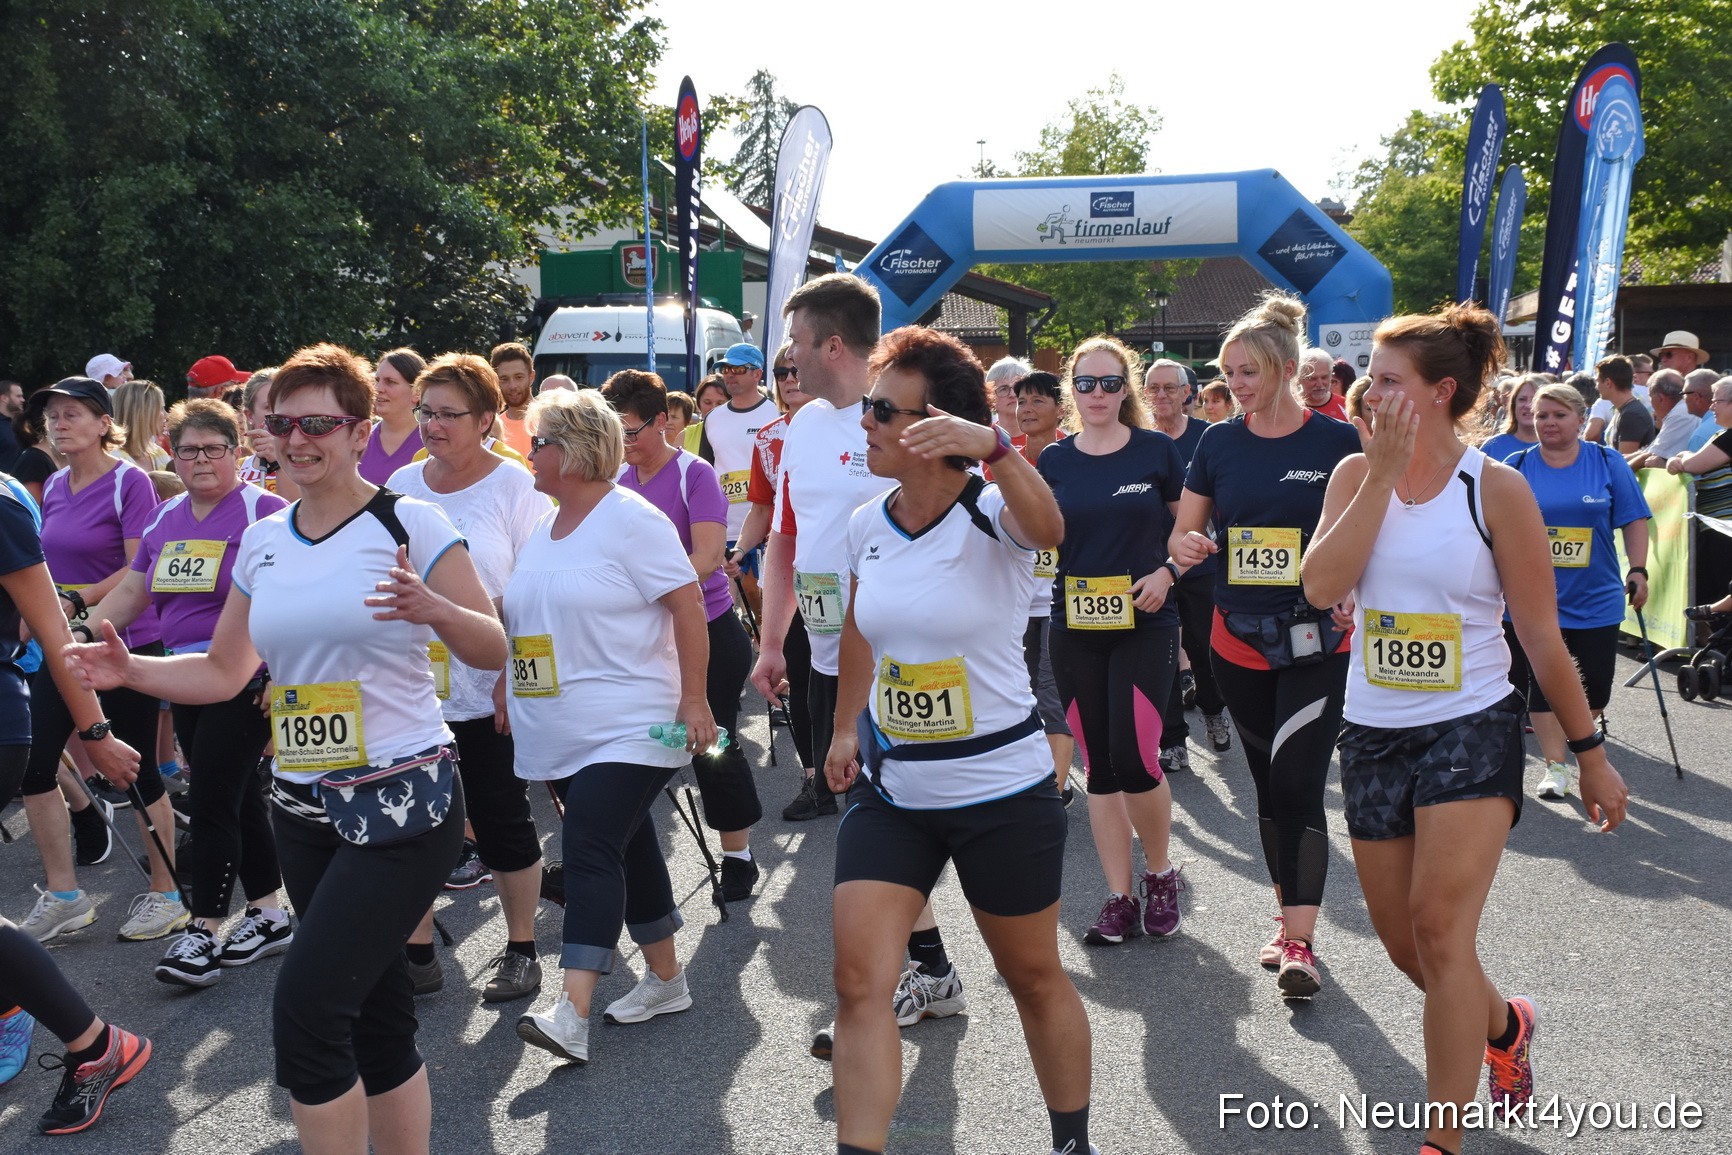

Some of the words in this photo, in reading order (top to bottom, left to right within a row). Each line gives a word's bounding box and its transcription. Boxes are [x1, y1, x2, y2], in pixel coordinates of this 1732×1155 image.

[1474, 110, 1495, 207] Fischer
[790, 130, 817, 222] Fischer
[801, 142, 820, 217] AUTOMOBILE
[1100, 200, 1132, 209] Fischer
[1074, 216, 1172, 237] firmenlauf
[1291, 243, 1306, 251] das
[890, 257, 942, 269] Fischer
[549, 331, 589, 341] abavent
[1280, 470, 1312, 481] JURA
[1113, 484, 1142, 496] JURA
[1235, 548, 1290, 569] 1439
[168, 558, 205, 577] 642
[799, 593, 825, 617] 371
[1073, 596, 1123, 615] 1389
[1373, 638, 1447, 669] 1889
[1378, 667, 1396, 675] Meier
[1398, 669, 1439, 677] Alexandra
[940, 679, 961, 689] 2019
[334, 704, 355, 713] 2019
[884, 686, 952, 719] 1891
[887, 715, 921, 728] Messinger
[923, 719, 955, 727] Martina
[281, 713, 347, 747] 1890
[906, 726, 957, 734] Krankengymnastik
[326, 745, 358, 754] Cornelia
[302, 755, 349, 763] Krankengymnastik
